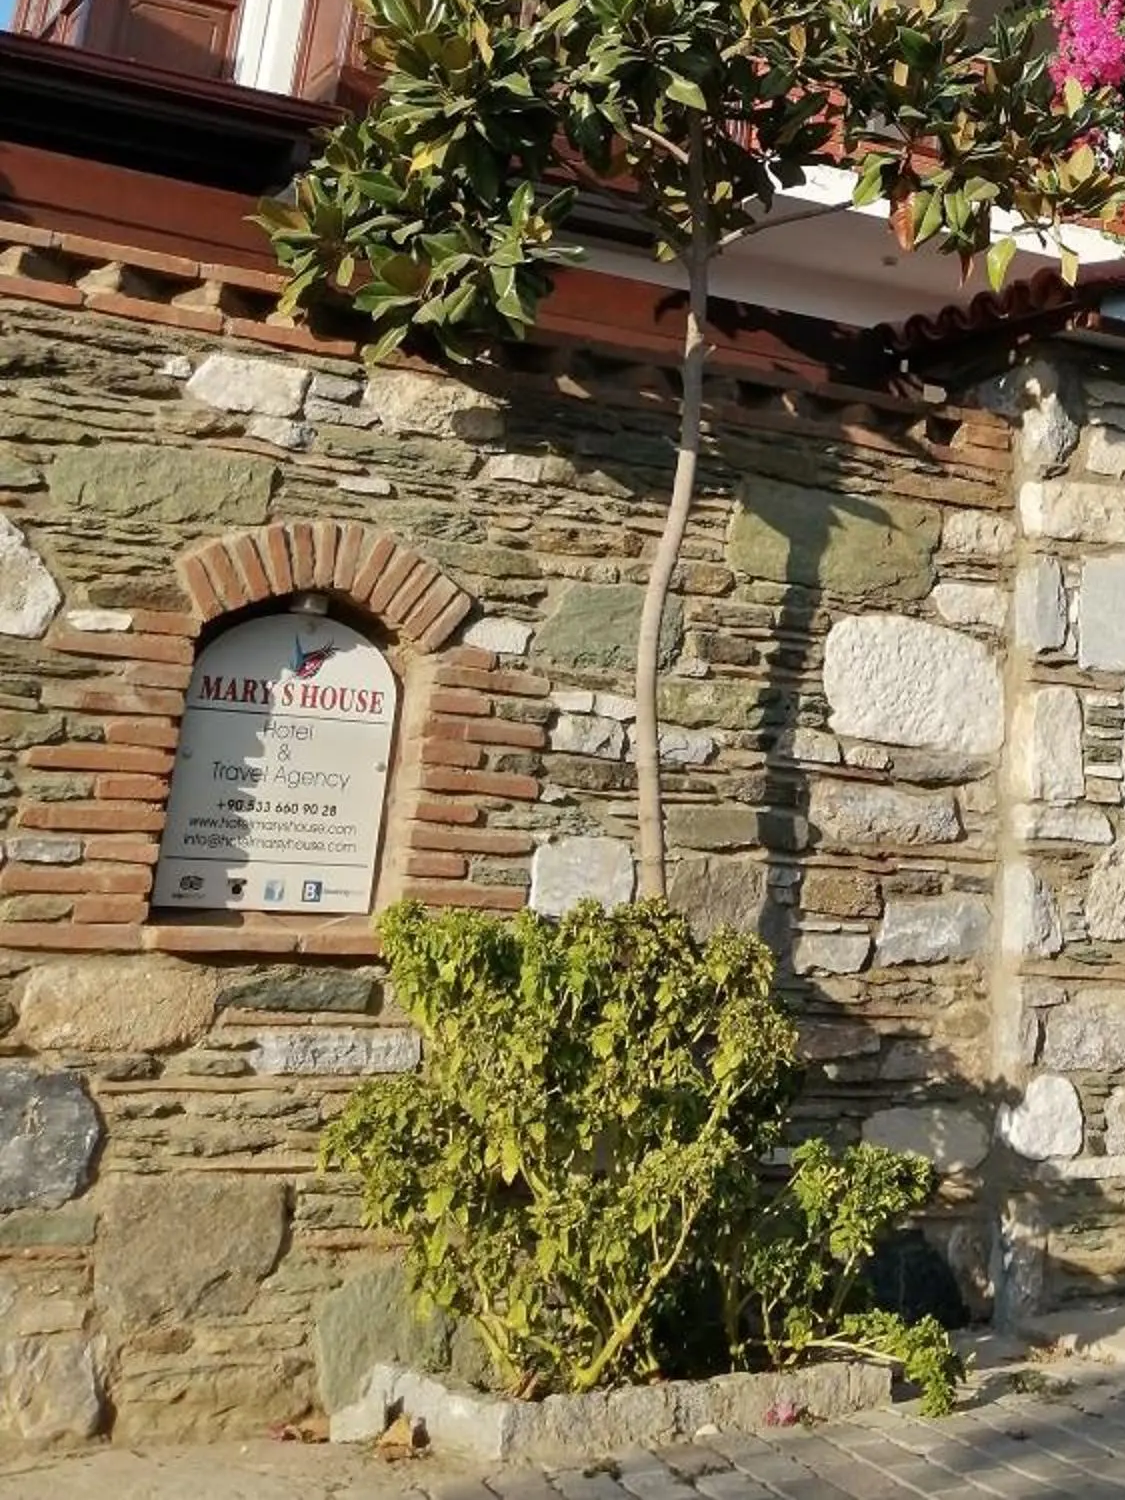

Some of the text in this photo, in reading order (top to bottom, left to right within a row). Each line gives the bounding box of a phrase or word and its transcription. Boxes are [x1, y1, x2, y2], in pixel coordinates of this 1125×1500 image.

[300, 683, 385, 715] HOUSE
[263, 720, 314, 741] Hotel
[276, 743, 291, 762] &
[212, 760, 351, 794] Travel Agency
[275, 801, 299, 815] 660
[303, 803, 319, 816] 90
[321, 804, 337, 817] 28
